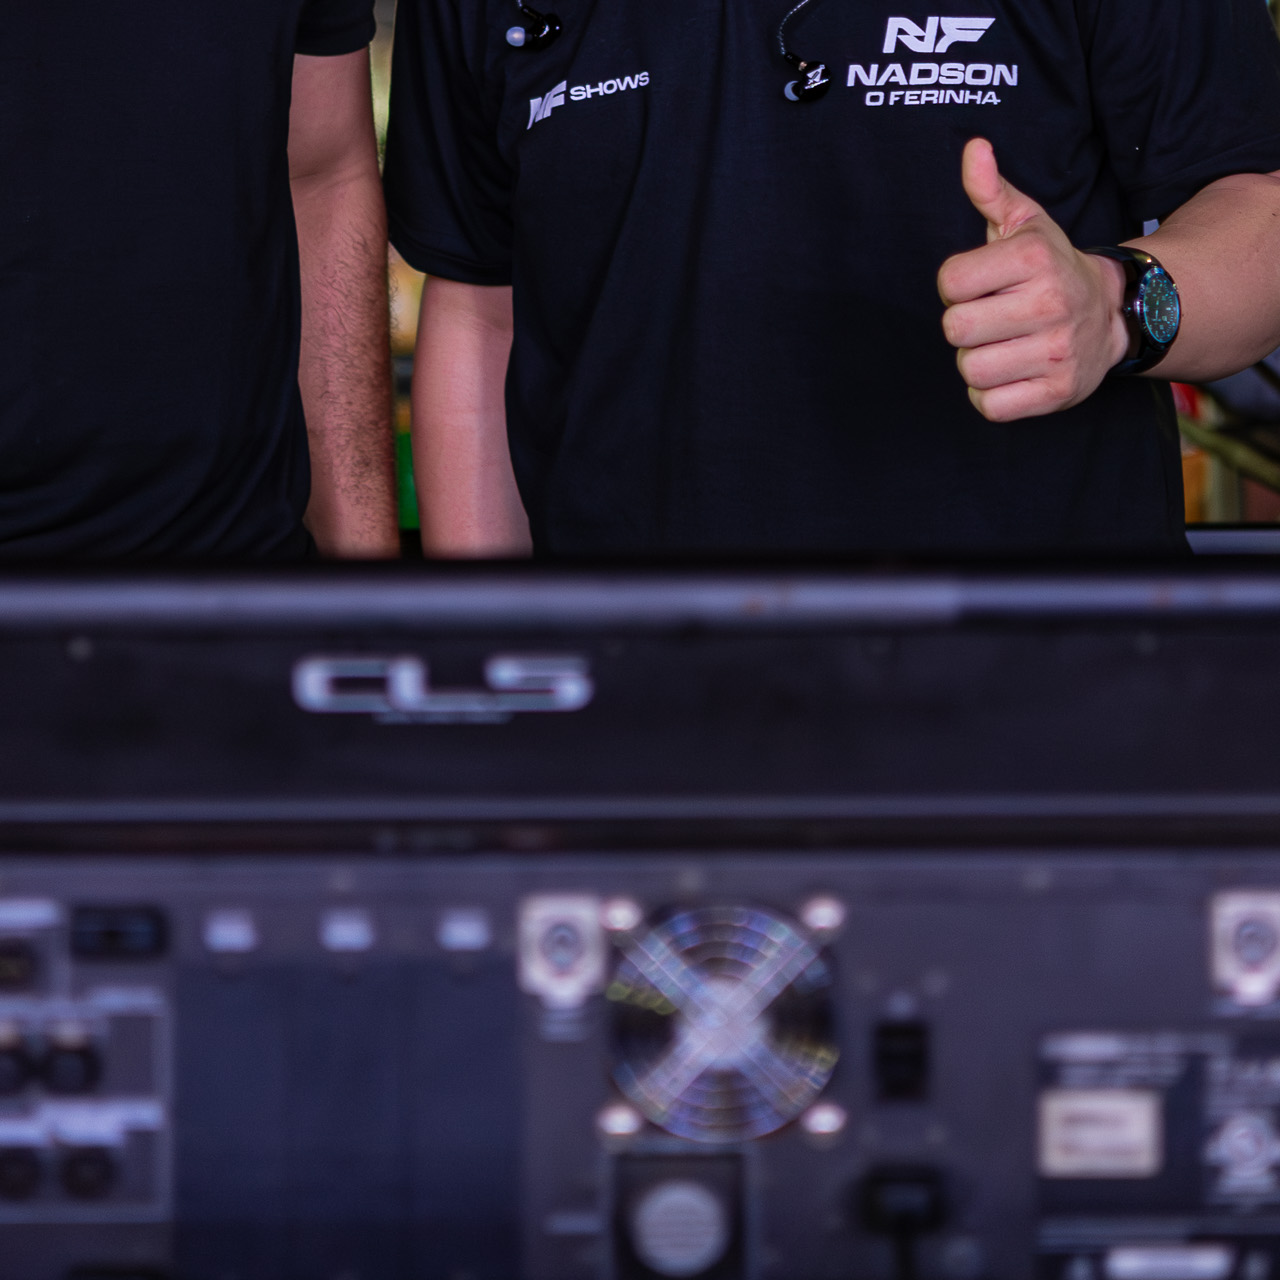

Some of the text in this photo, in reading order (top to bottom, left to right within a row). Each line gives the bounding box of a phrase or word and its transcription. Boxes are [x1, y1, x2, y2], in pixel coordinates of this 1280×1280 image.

[570, 71, 650, 101] SHOWS
[846, 62, 1018, 87] NADSON
[865, 89, 1001, 106] O FERINHA
